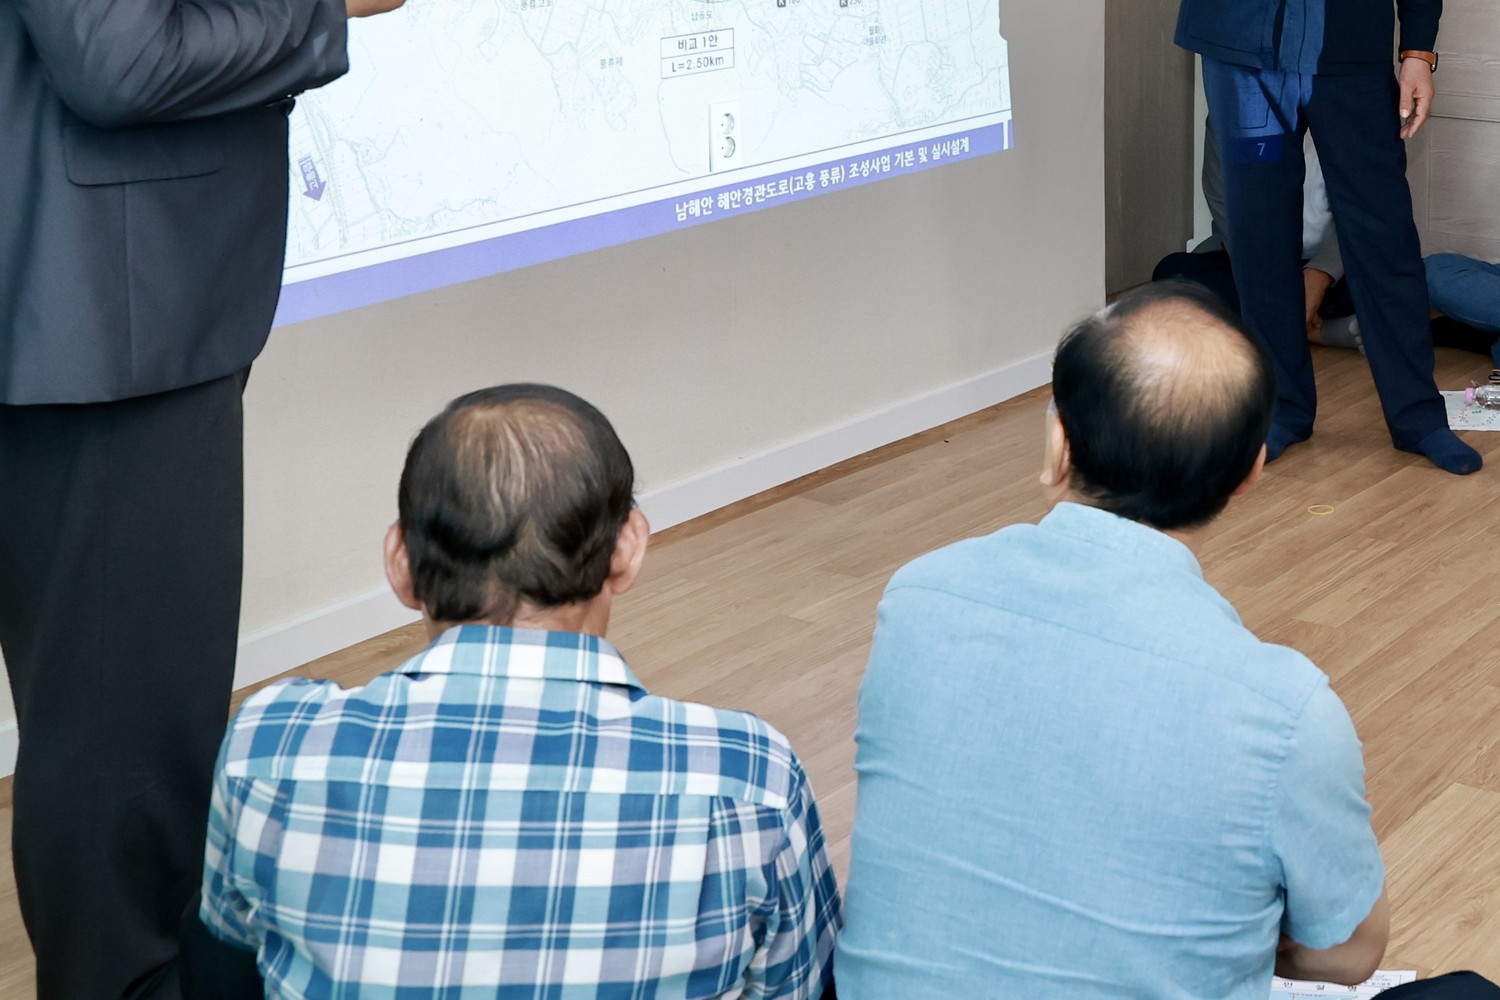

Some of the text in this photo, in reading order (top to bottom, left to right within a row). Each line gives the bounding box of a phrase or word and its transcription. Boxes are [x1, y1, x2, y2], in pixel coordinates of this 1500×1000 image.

[678, 35, 718, 51] 비교 1안
[672, 55, 724, 73] L=2.50km
[675, 136, 969, 222] 남해안 해안경관도로(고흥 풍류) 조성사업 기본 및 실시설계
